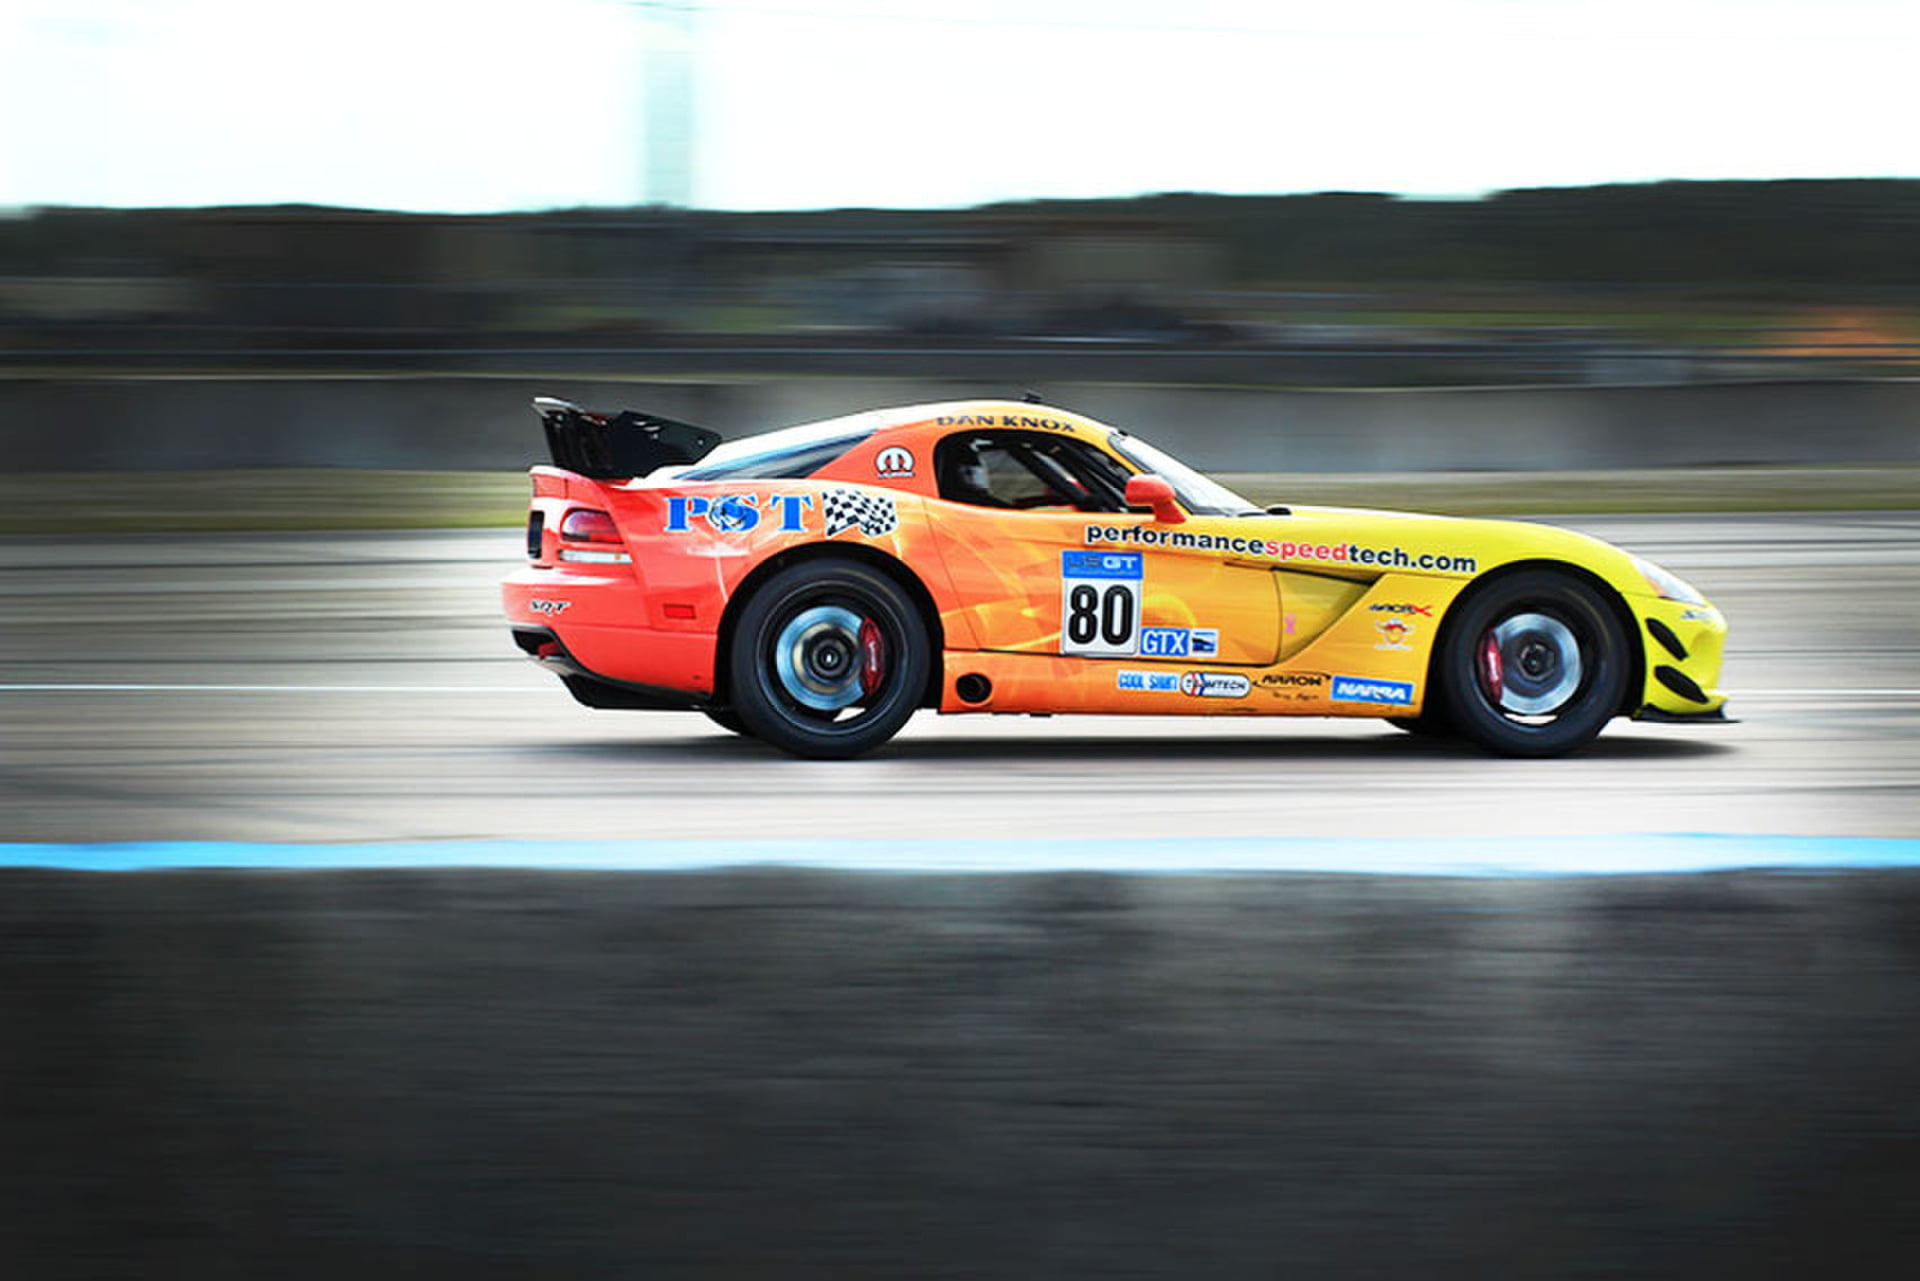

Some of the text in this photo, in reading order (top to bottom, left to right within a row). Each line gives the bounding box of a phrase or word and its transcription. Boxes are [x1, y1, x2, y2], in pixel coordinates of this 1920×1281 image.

[936, 415, 1076, 433] DAN KNOX
[1086, 523, 1477, 573] performancespeedtech.com
[1068, 584, 1134, 645] 80
[1143, 629, 1187, 654] GTX
